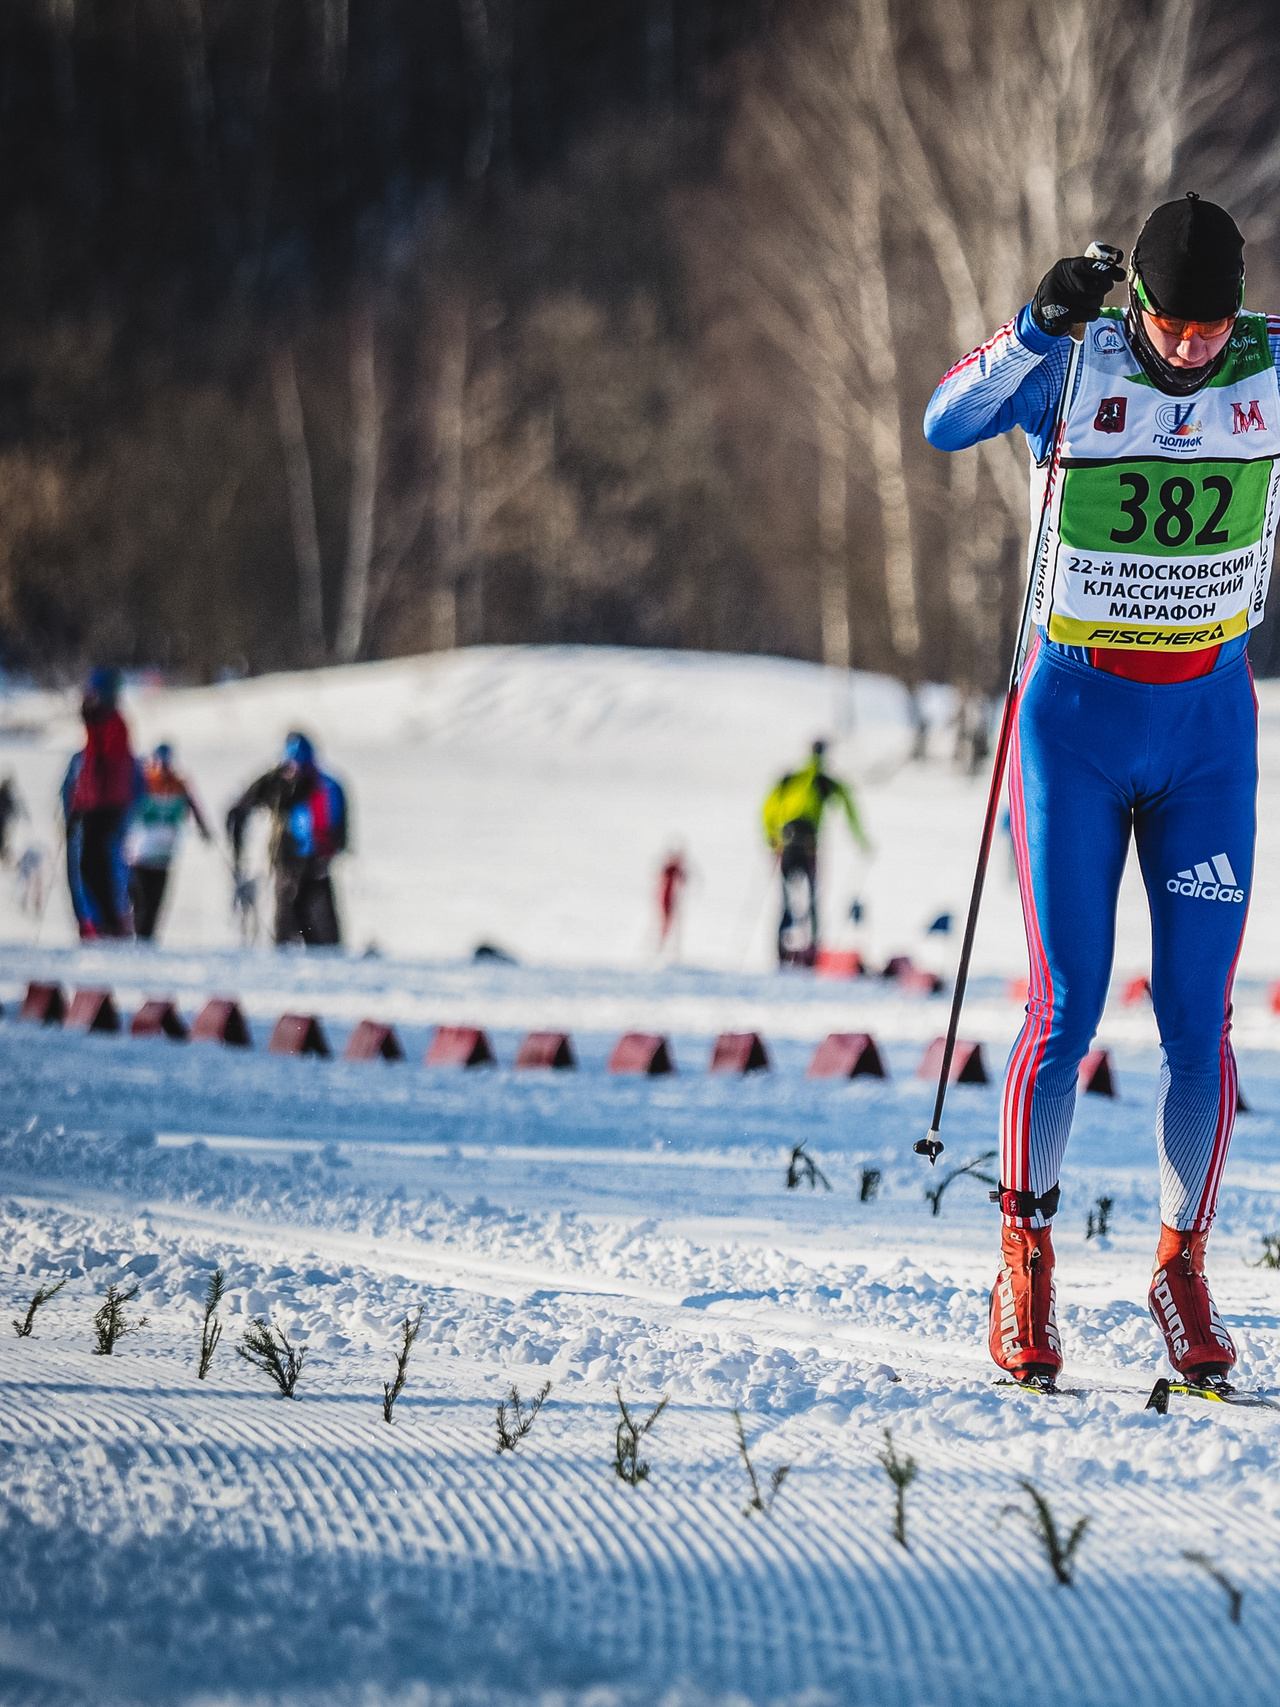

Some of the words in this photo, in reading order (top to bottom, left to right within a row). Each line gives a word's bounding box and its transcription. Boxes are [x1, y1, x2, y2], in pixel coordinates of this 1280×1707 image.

[1109, 472, 1234, 548] 382
[1068, 557, 1114, 577] 22-й
[1119, 550, 1254, 581] МОСКОВСКИЙ
[1083, 574, 1244, 601] КЛАССИЧЕСКИЙ
[1108, 602, 1216, 621] МАРАФОН
[1087, 629, 1210, 646] FISCHER
[1166, 878, 1245, 904] adidas
